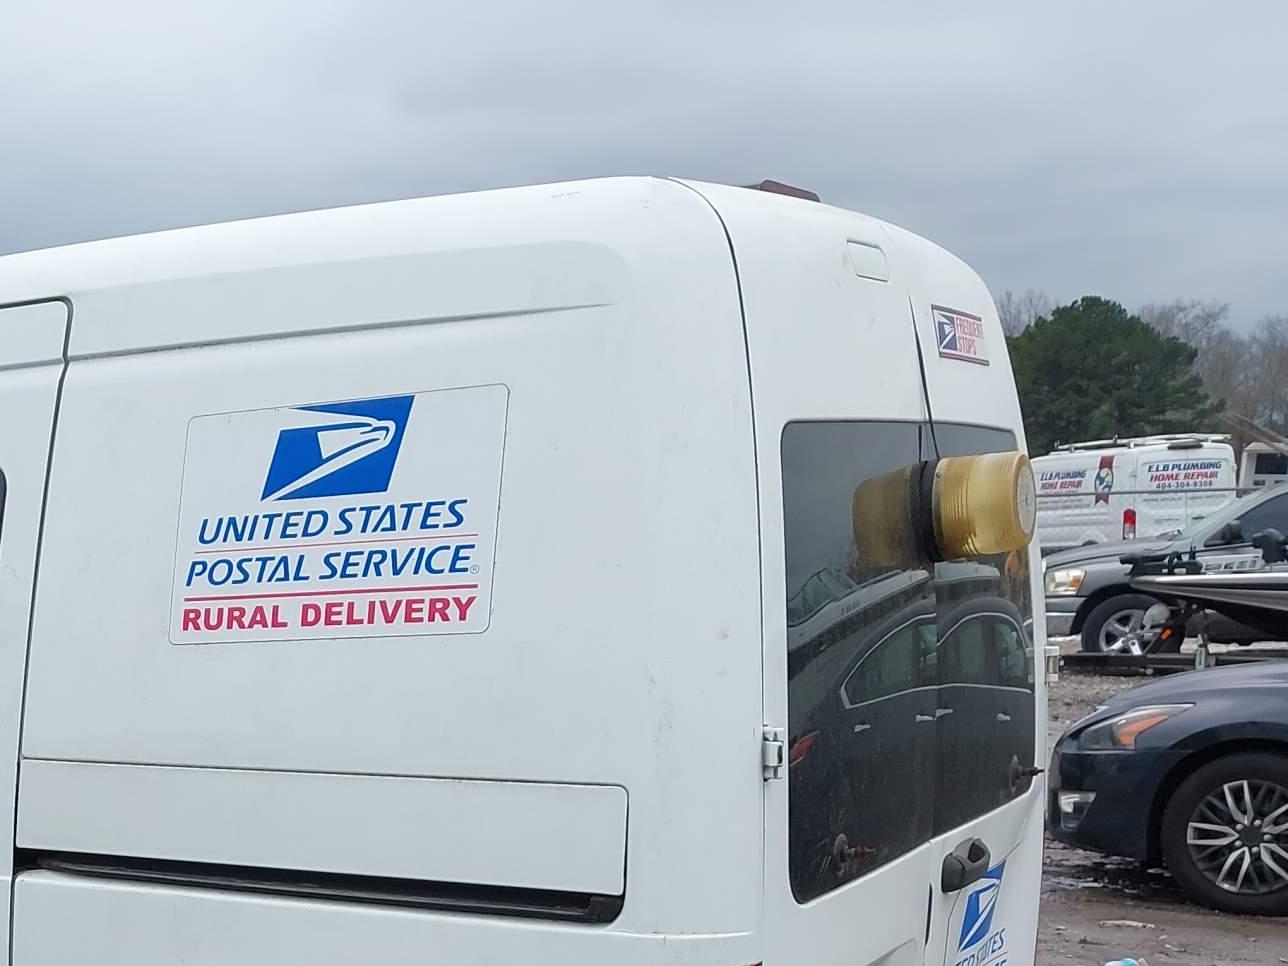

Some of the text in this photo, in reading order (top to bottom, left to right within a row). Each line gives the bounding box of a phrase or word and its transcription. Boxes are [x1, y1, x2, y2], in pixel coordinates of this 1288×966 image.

[956, 316, 984, 340] FREQUENT
[957, 336, 977, 355] STOPS
[1150, 470, 1219, 482] HOME REPAIR
[1171, 461, 1222, 471] PLUMBING
[198, 499, 468, 545] UNITED STATES
[185, 544, 476, 587] POSTAL SERVICE
[182, 596, 479, 631] RURAL DELIVERY
